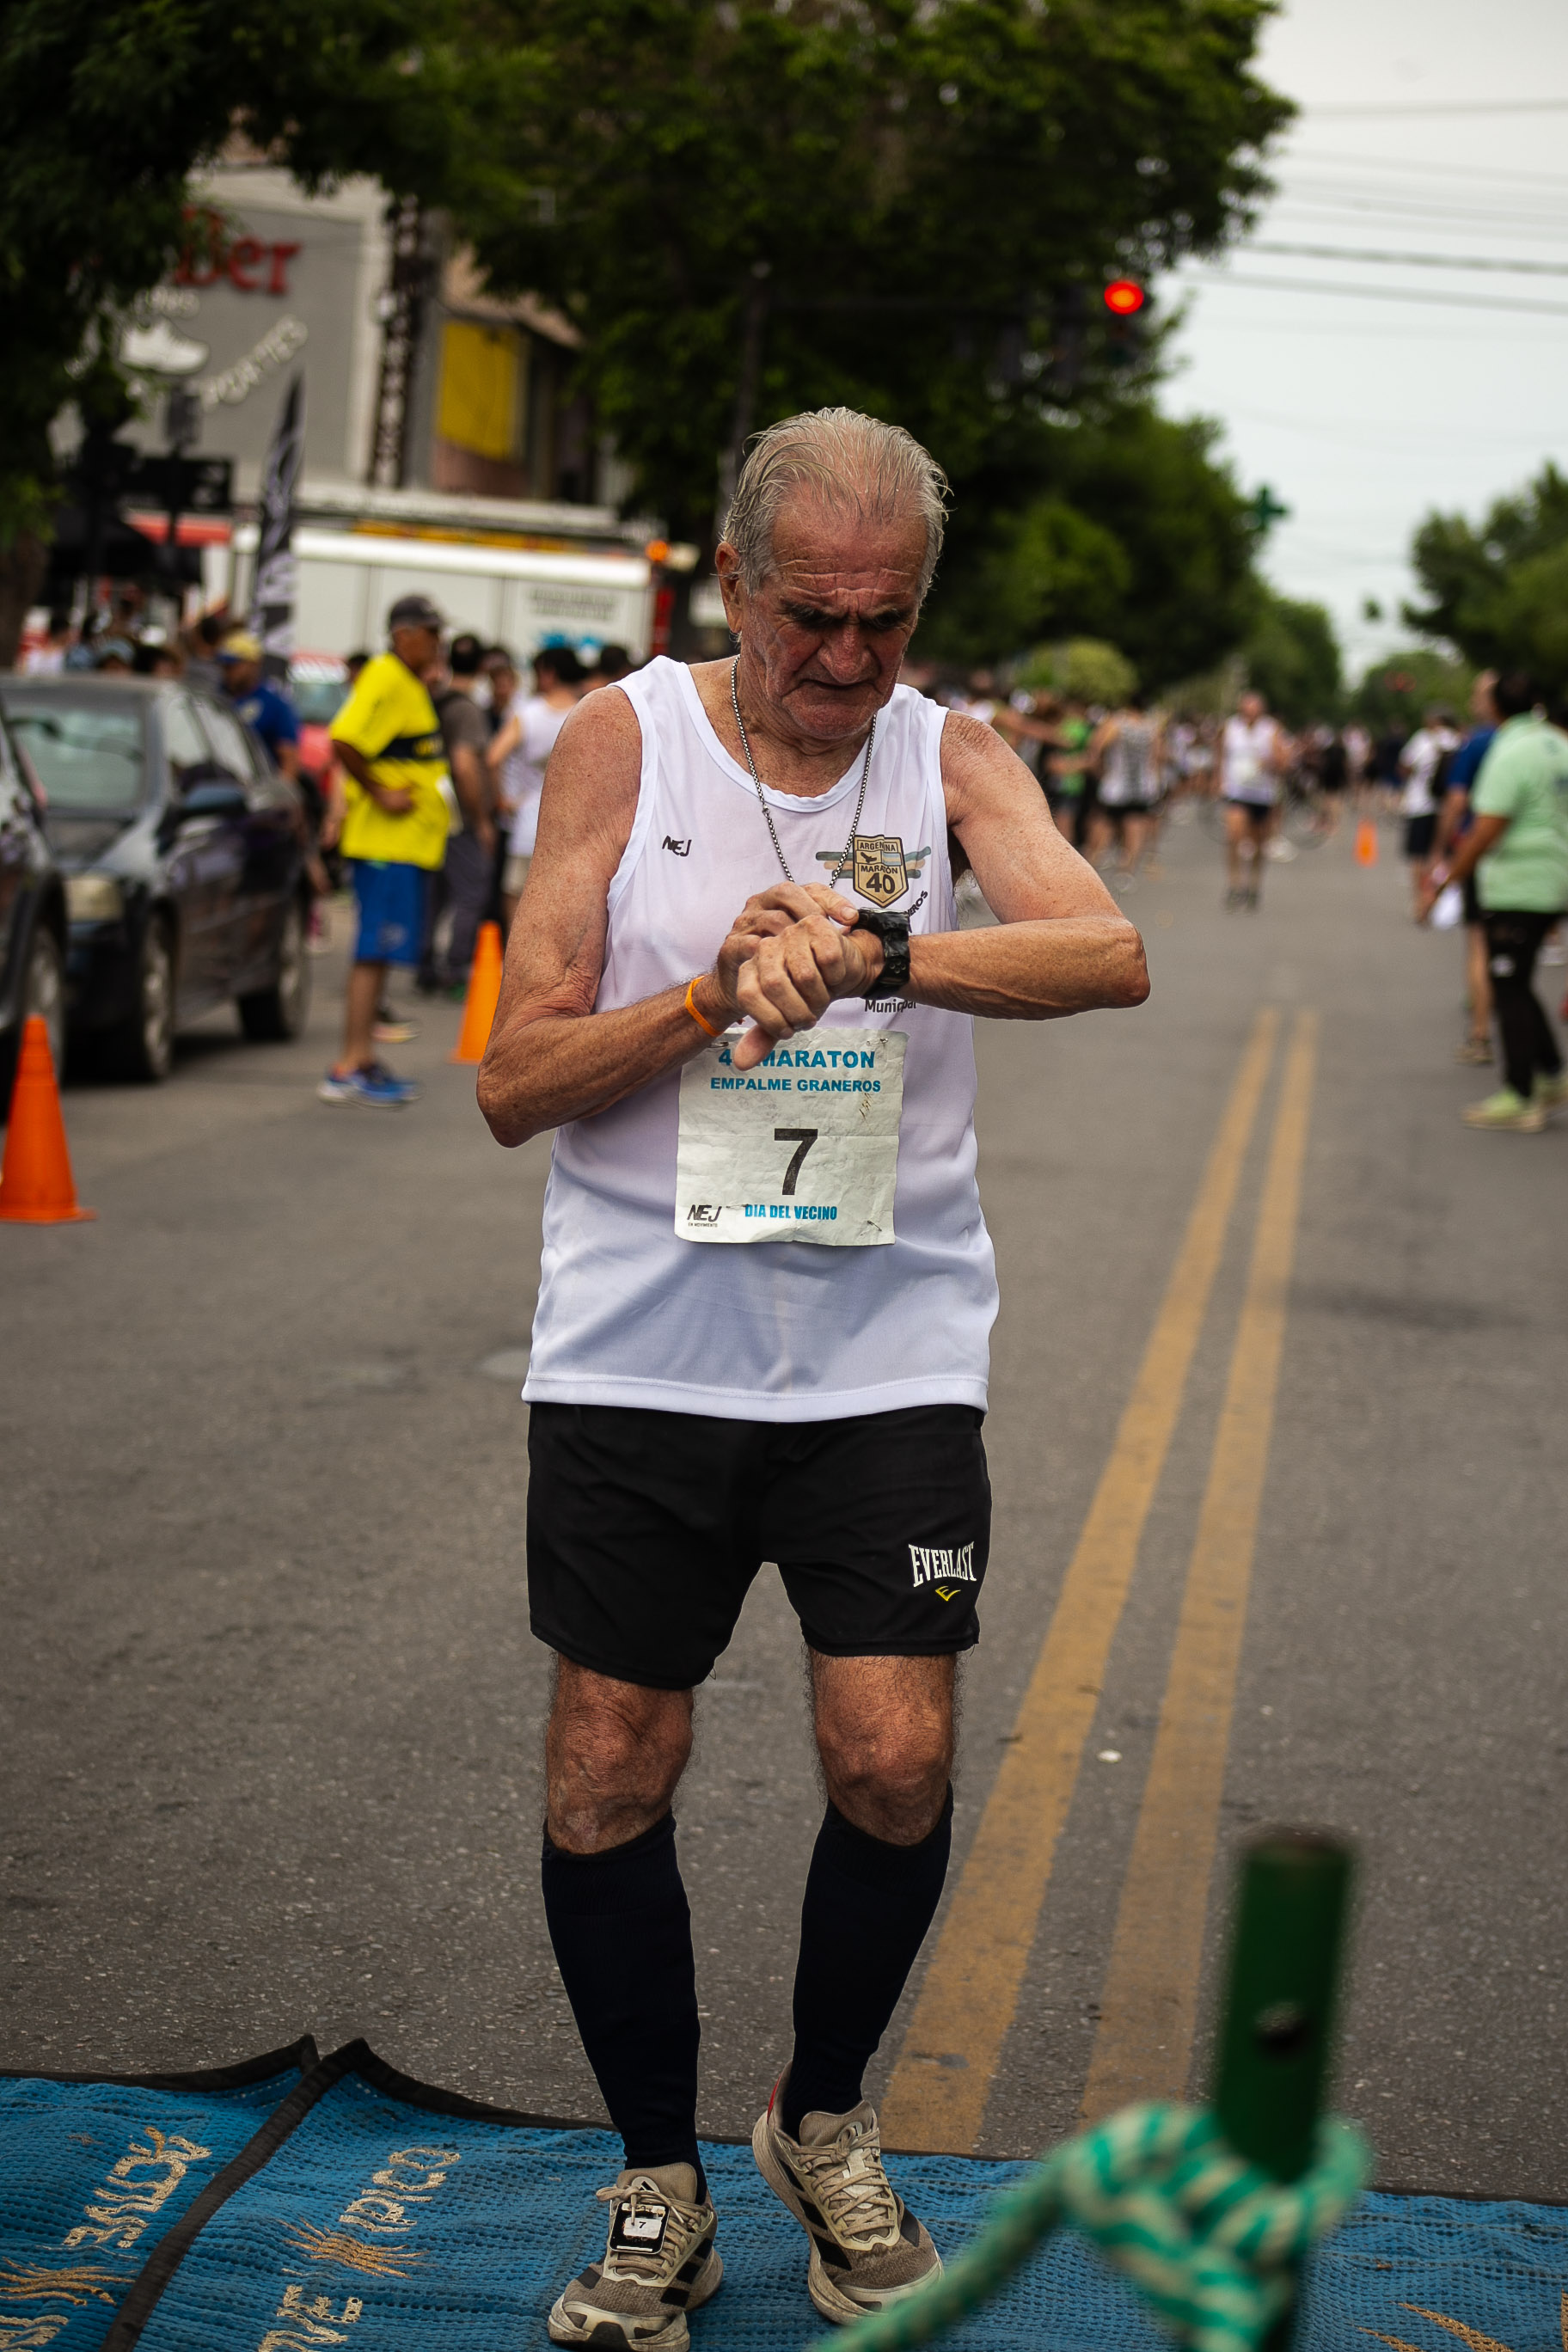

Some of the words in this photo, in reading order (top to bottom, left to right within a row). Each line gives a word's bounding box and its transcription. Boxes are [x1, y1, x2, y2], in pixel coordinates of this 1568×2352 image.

[662, 835, 692, 857] NEJ
[860, 842, 897, 852] ARGENNA
[866, 872, 896, 894] 40
[710, 1077, 792, 1091] EMPALME
[797, 1079, 881, 1093] GRANEROS
[774, 1128, 818, 1196] 7
[687, 1204, 722, 1222] NEJ
[744, 1204, 767, 1217] DIA
[769, 1205, 791, 1219] DEL
[794, 1205, 837, 1221] VECINO
[909, 1541, 977, 1587] EVERLAST
[638, 2220, 646, 2229] 7
